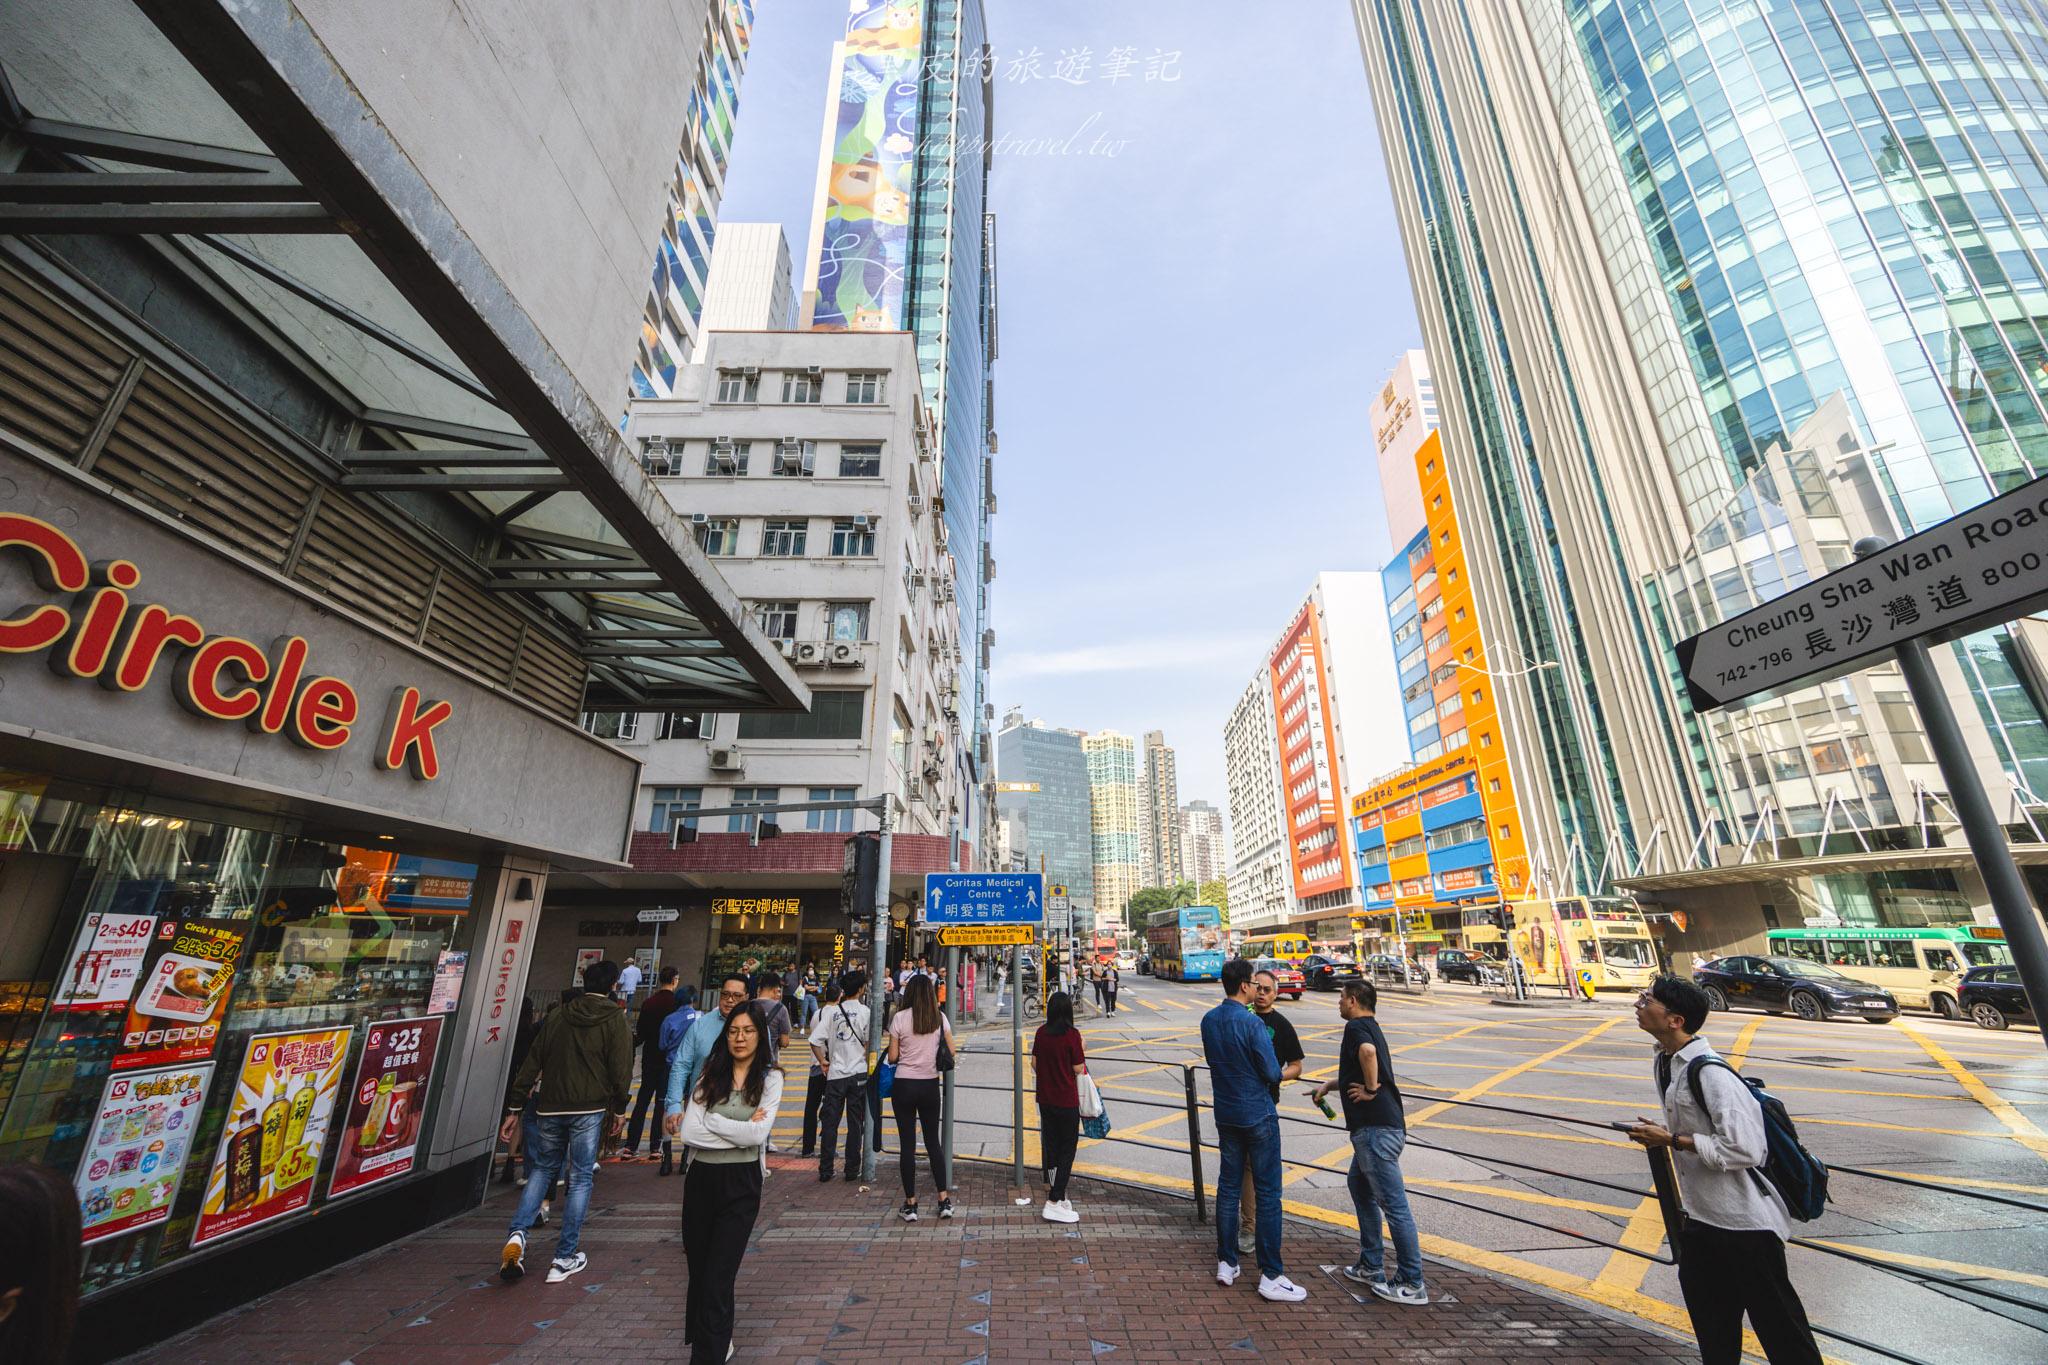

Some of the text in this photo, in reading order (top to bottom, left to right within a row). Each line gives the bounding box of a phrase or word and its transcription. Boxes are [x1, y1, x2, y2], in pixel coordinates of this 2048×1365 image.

[1727, 602, 1814, 648] Cheung
[1820, 577, 1875, 609] Sha
[1881, 543, 1953, 583] Wan
[1804, 573, 1973, 660] 長沙灣道
[0, 512, 453, 781] Circle K
[945, 878, 1024, 888] Caritas Medical
[968, 889, 1002, 899] Centre
[726, 898, 800, 916] 聖安娜餅屋
[945, 903, 1005, 918] 明愛醫院
[184, 922, 208, 934] Circle
[960, 928, 981, 936] Cheung
[484, 948, 515, 1045] Circle K
[389, 1027, 423, 1053] $23
